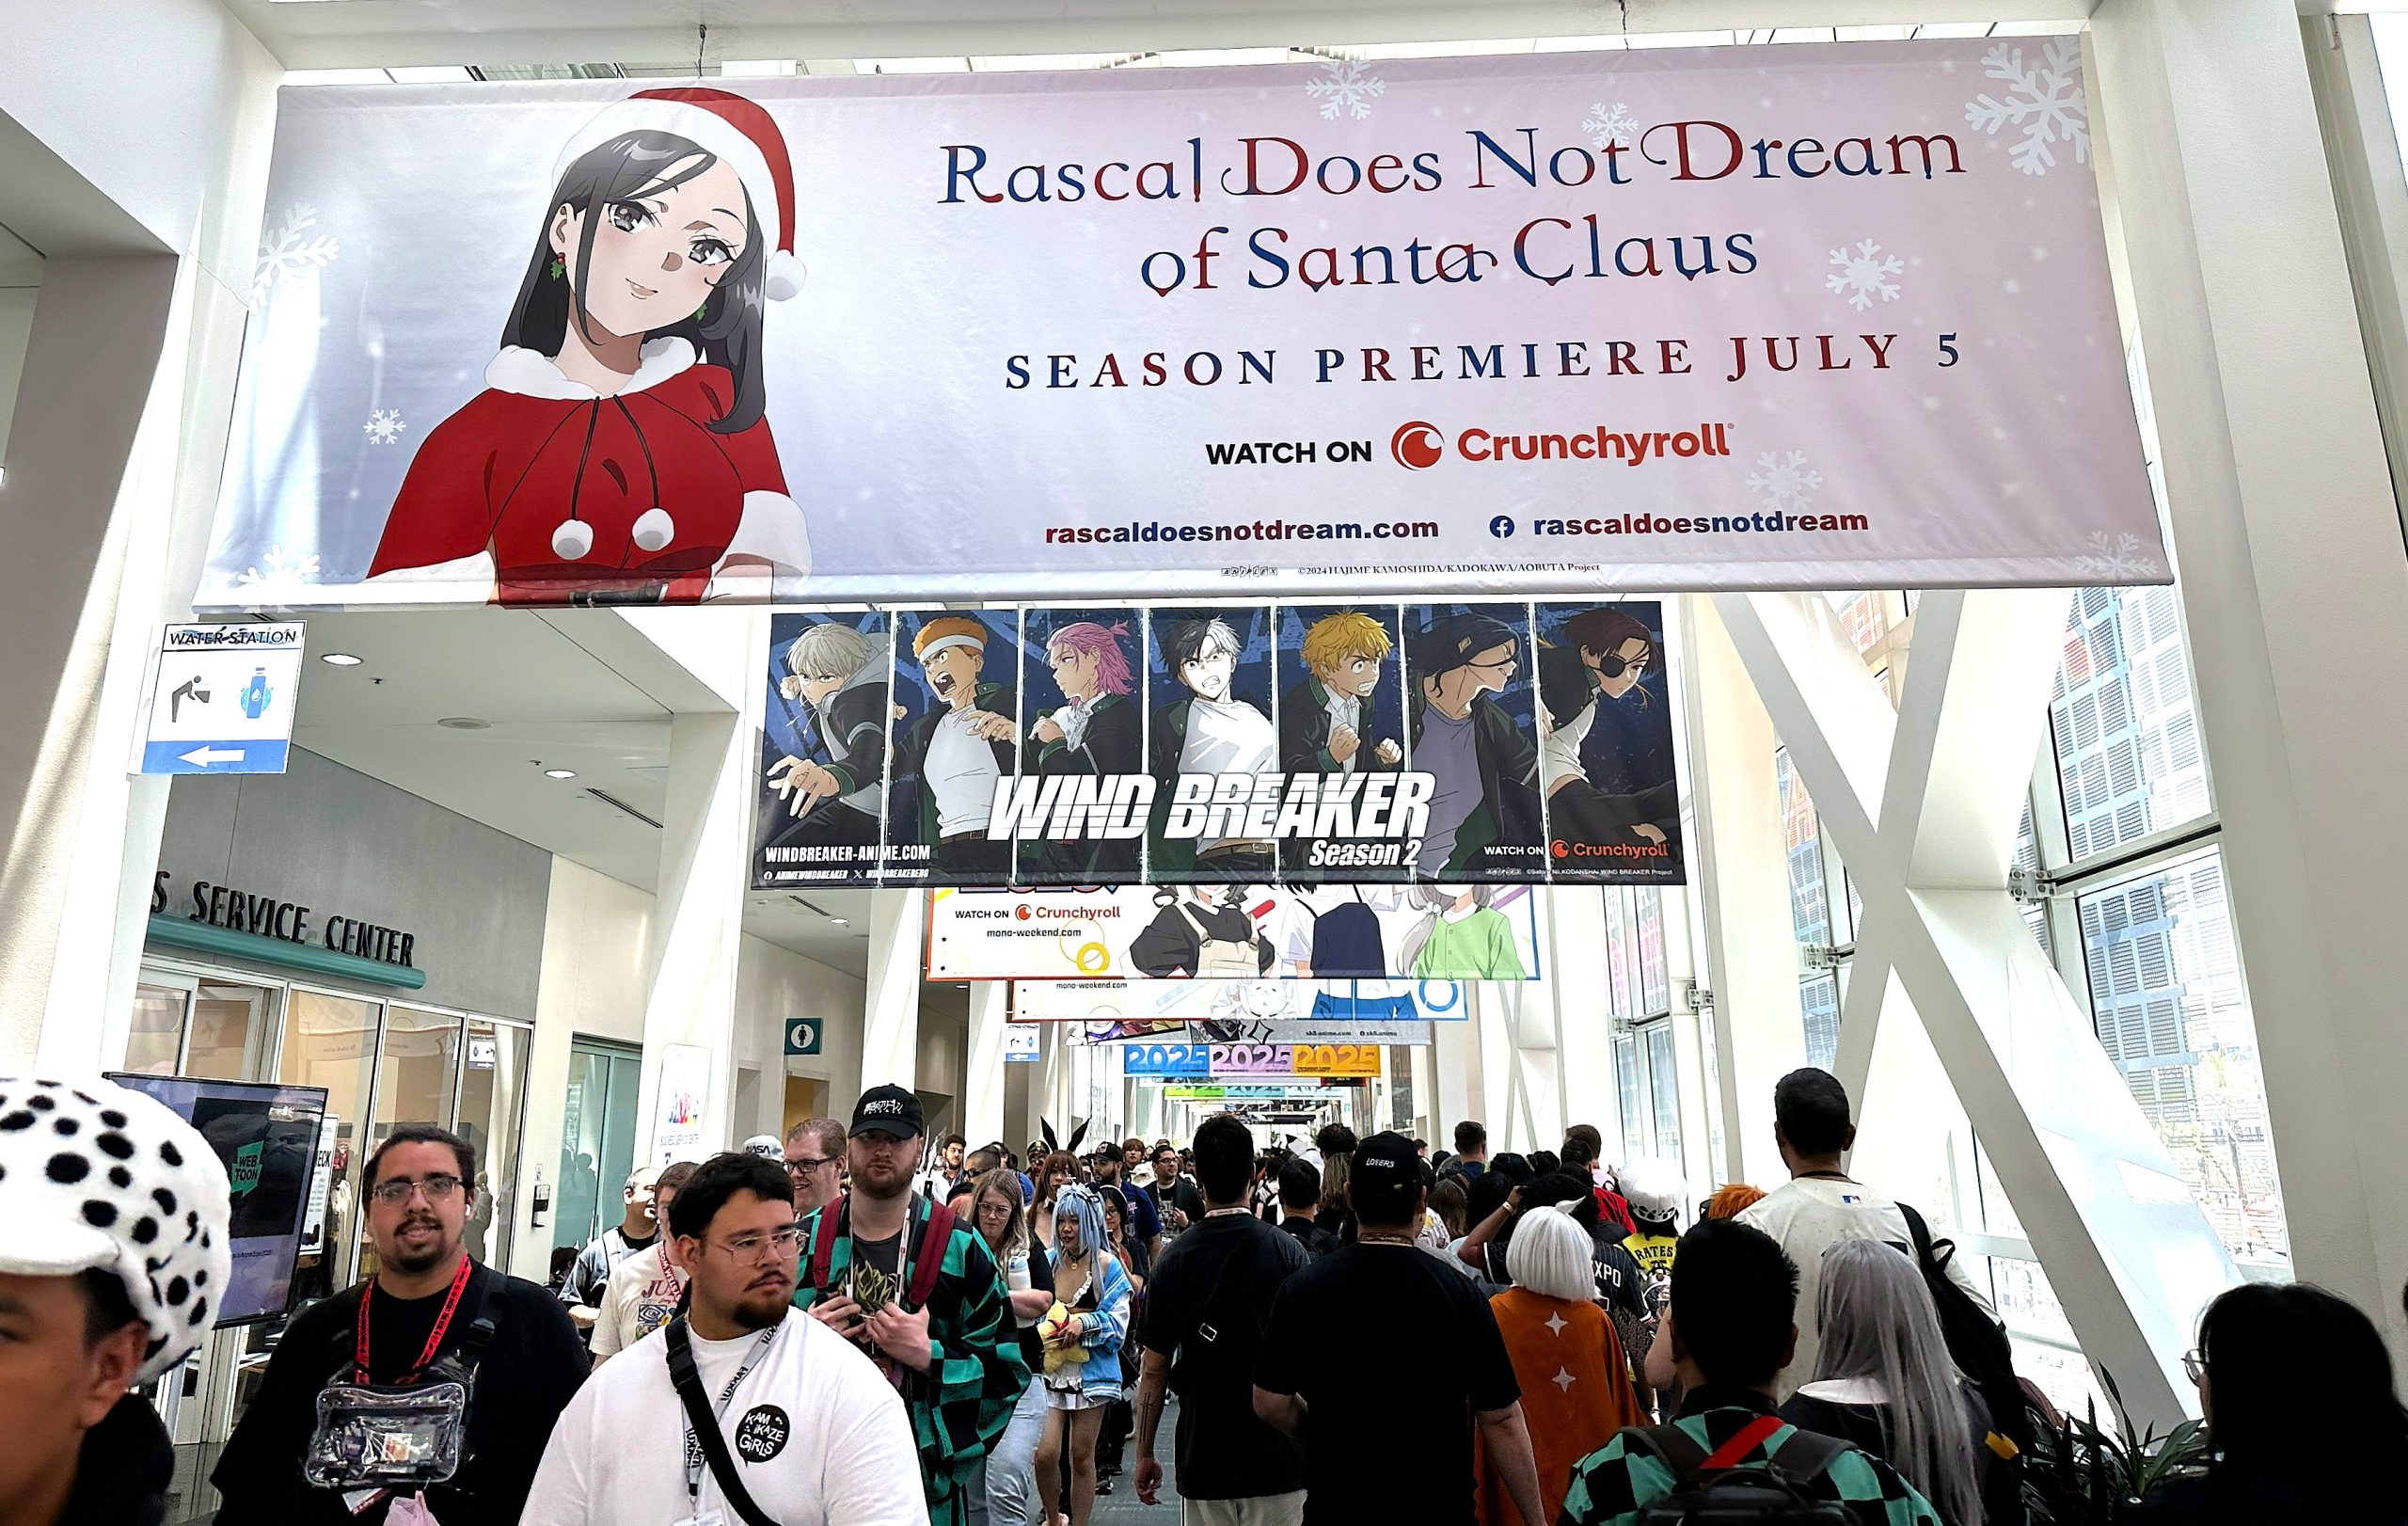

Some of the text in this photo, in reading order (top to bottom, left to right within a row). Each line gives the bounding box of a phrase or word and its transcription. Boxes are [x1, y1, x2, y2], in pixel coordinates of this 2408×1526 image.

[937, 119, 1967, 202] Rascal Does Not Dream
[1140, 214, 1758, 297] of Santa Claus
[1006, 331, 1960, 389] SEASON PREMIERE JULY 5
[1205, 441, 1317, 465] WATCH
[1325, 439, 1372, 463] ON
[1045, 519, 1439, 543] rascaldoesnotdream.com
[1533, 511, 1869, 535] rascaldoesnotdream
[1328, 565, 1370, 575] HAJIME
[1567, 562, 1600, 572] Project
[169, 629, 297, 645] WATER STATION
[988, 771, 1437, 840] WIND BREAKER
[765, 844, 931, 863] WINDBREAKER-ANIME.COM
[1308, 839, 1422, 866] Season 2
[1483, 846, 1524, 855] WATCH
[1527, 846, 1545, 855] ON
[189, 881, 310, 944] SERVICE
[325, 915, 416, 967] CENTER
[955, 910, 991, 919] WATCH
[993, 910, 1009, 919] ON
[987, 927, 1082, 938] mono-weekend.com
[1056, 981, 1128, 990] mono-weekend.com
[1128, 1045, 1208, 1068] 2025
[1212, 1045, 1291, 1068] 2025
[1296, 1045, 1375, 1068] 2025
[239, 1154, 259, 1168] WEB
[234, 1168, 259, 1182] TOON
[1634, 1245, 1674, 1261] RATES
[1593, 1260, 1622, 1288] XPO
[745, 1412, 771, 1425] KAM
